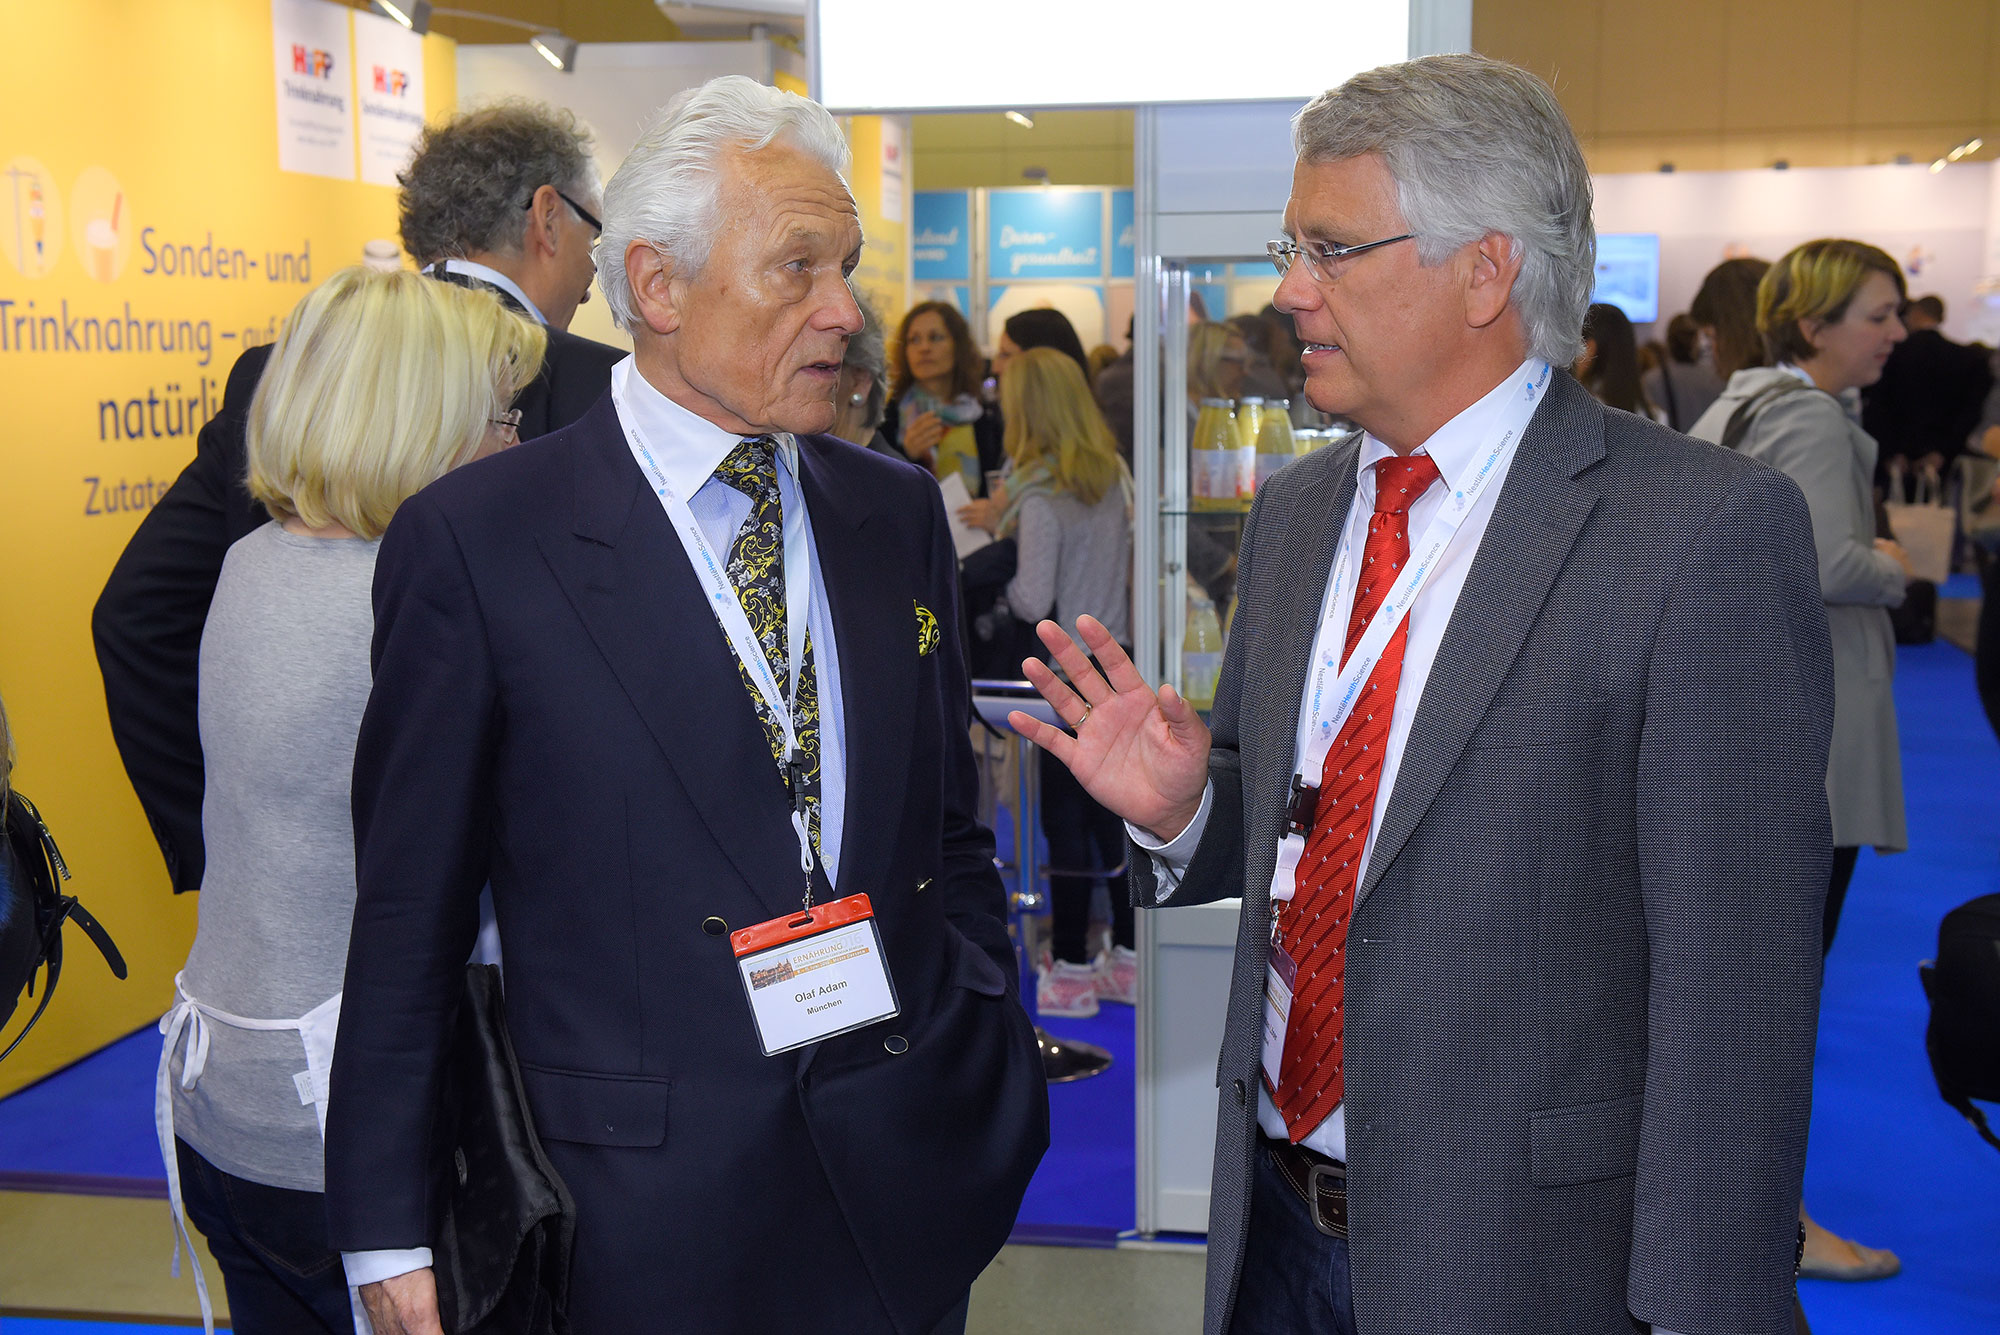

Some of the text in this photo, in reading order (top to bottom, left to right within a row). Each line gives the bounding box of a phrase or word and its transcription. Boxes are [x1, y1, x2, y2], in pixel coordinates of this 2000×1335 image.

[141, 227, 311, 284] Sonden- und
[0, 299, 213, 367] Trinknahrung
[98, 378, 217, 441] natürli
[84, 477, 175, 516] Zutate
[793, 943, 843, 964] ERNÄHRUNG
[795, 980, 848, 1003] Olaf Adam
[807, 999, 842, 1015] München
